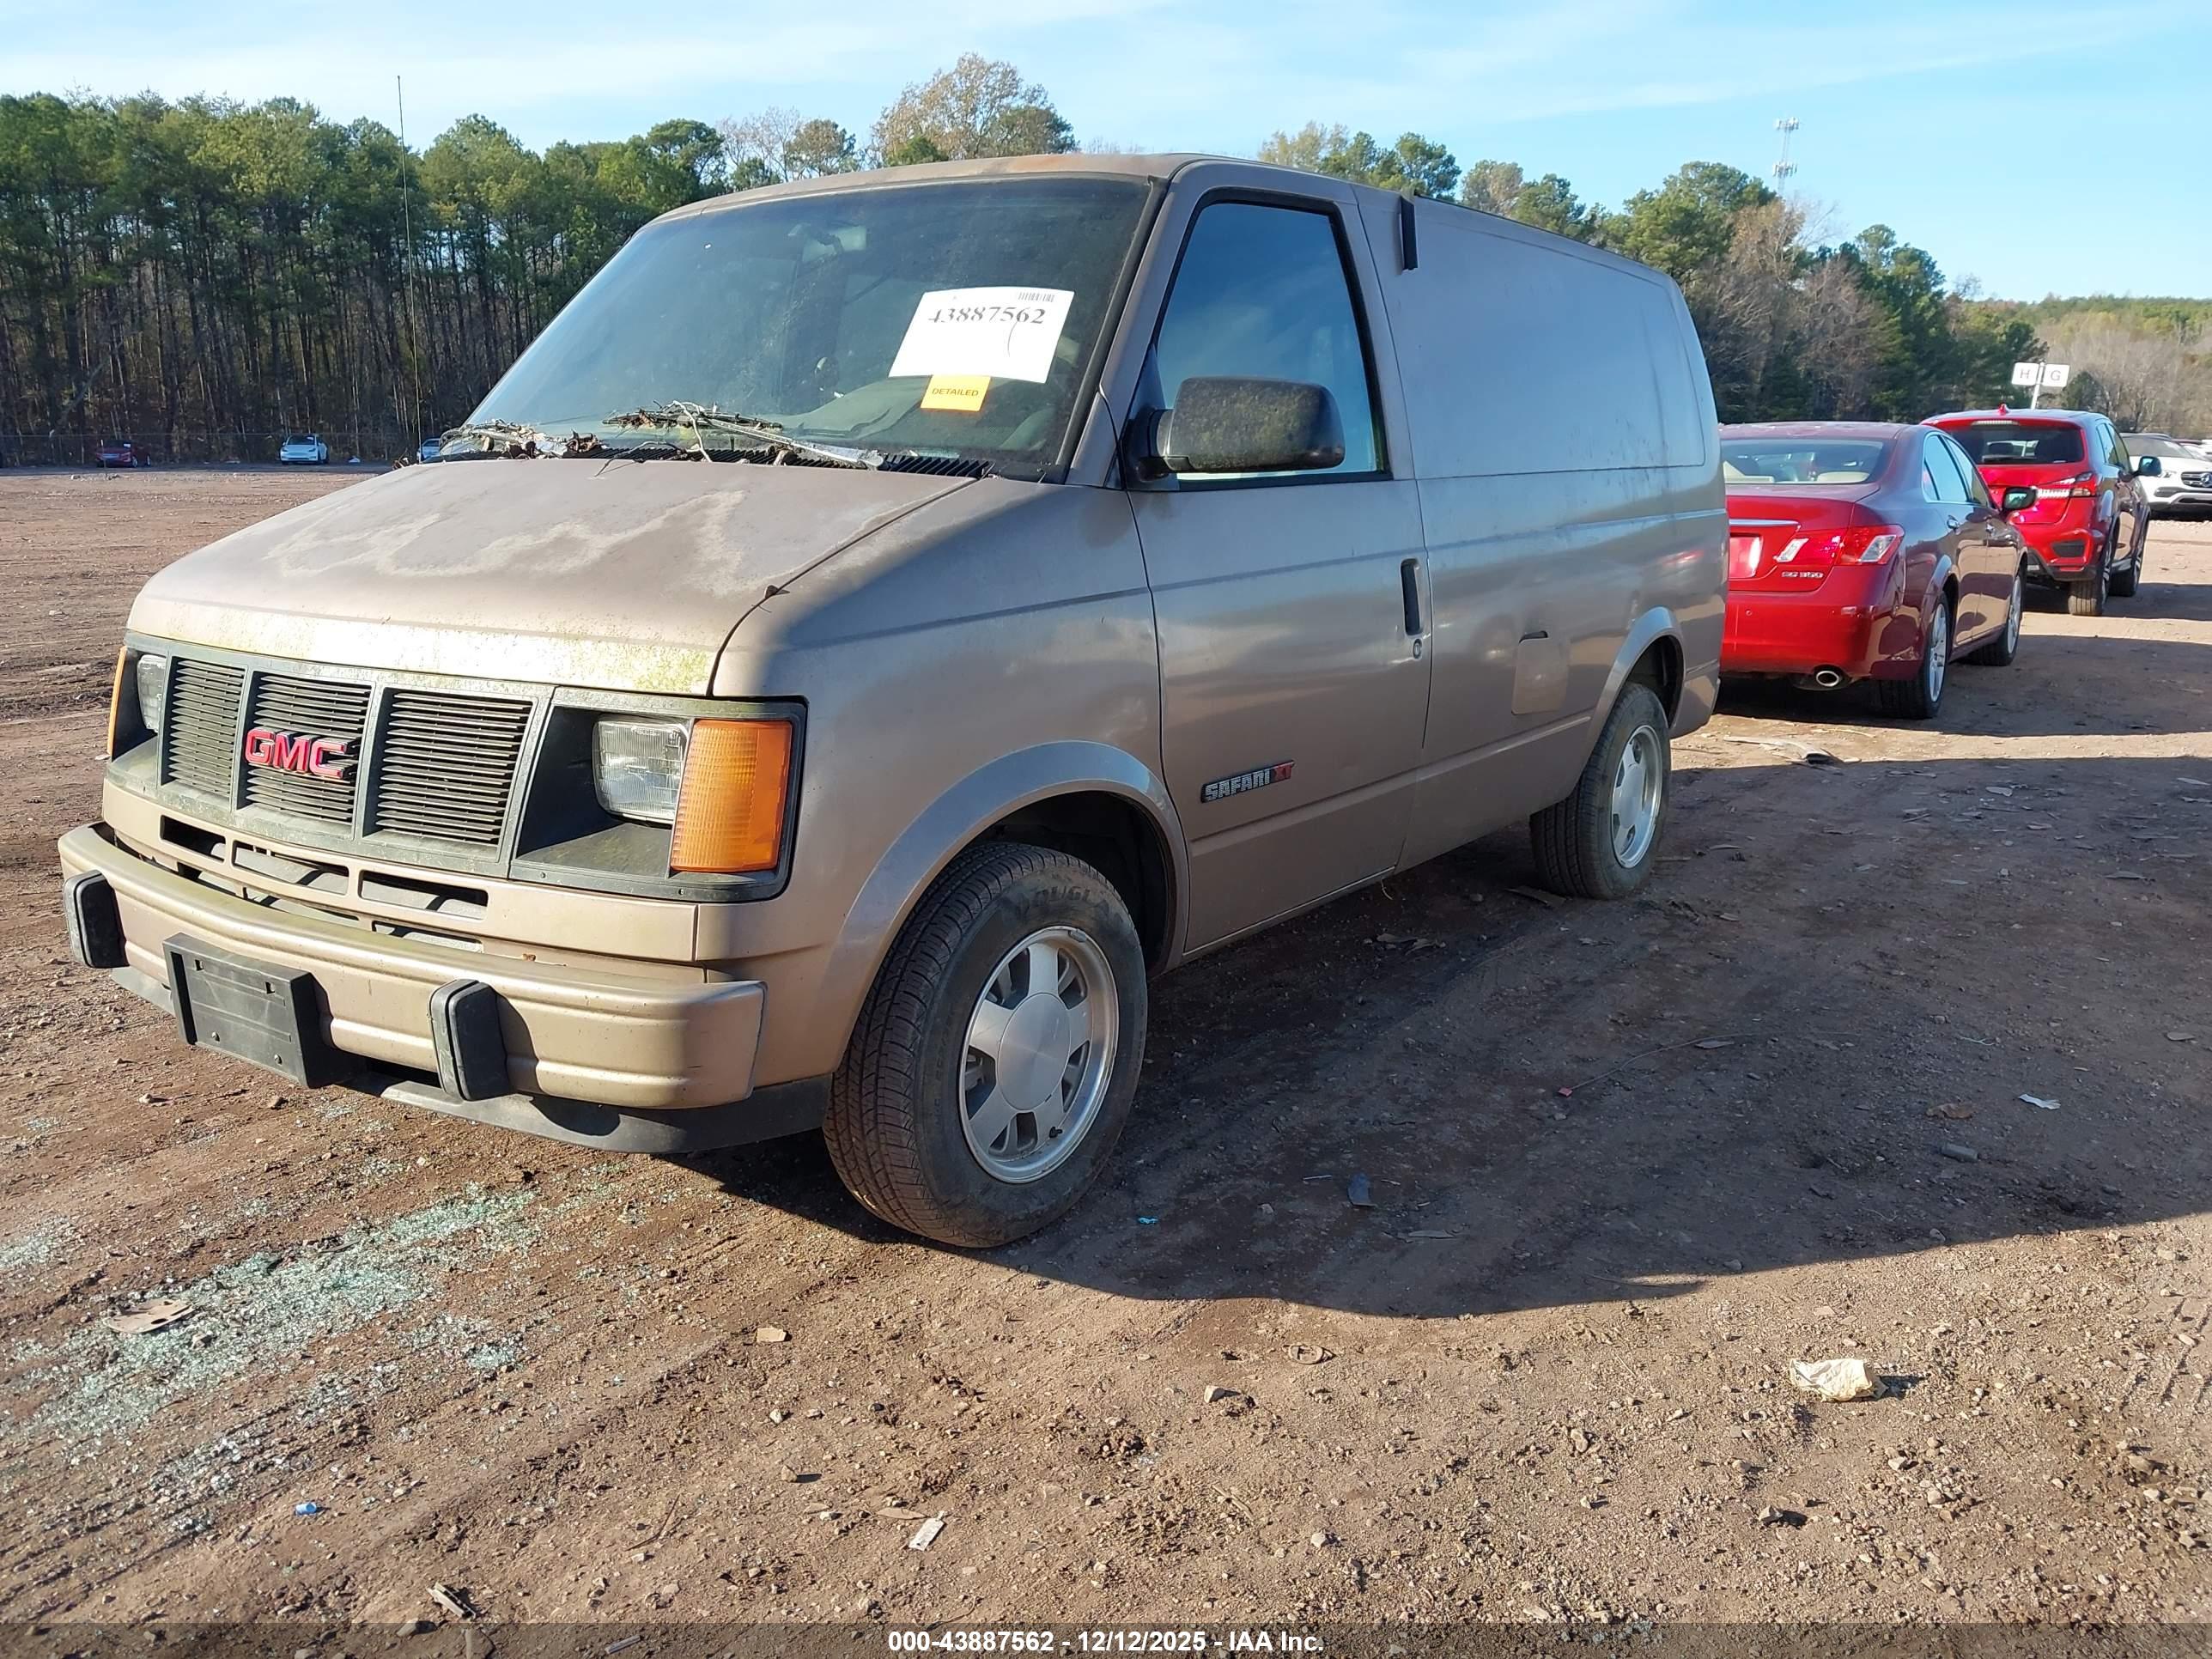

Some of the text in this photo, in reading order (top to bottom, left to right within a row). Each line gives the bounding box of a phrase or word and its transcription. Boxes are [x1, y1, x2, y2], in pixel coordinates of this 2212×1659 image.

[927, 306, 1047, 325] 43887562
[2019, 367, 2030, 380] H
[2049, 368, 2061, 380] G
[932, 386, 979, 397] DETAILED
[245, 726, 347, 779] GMC
[1204, 768, 1271, 802] SAFARI
